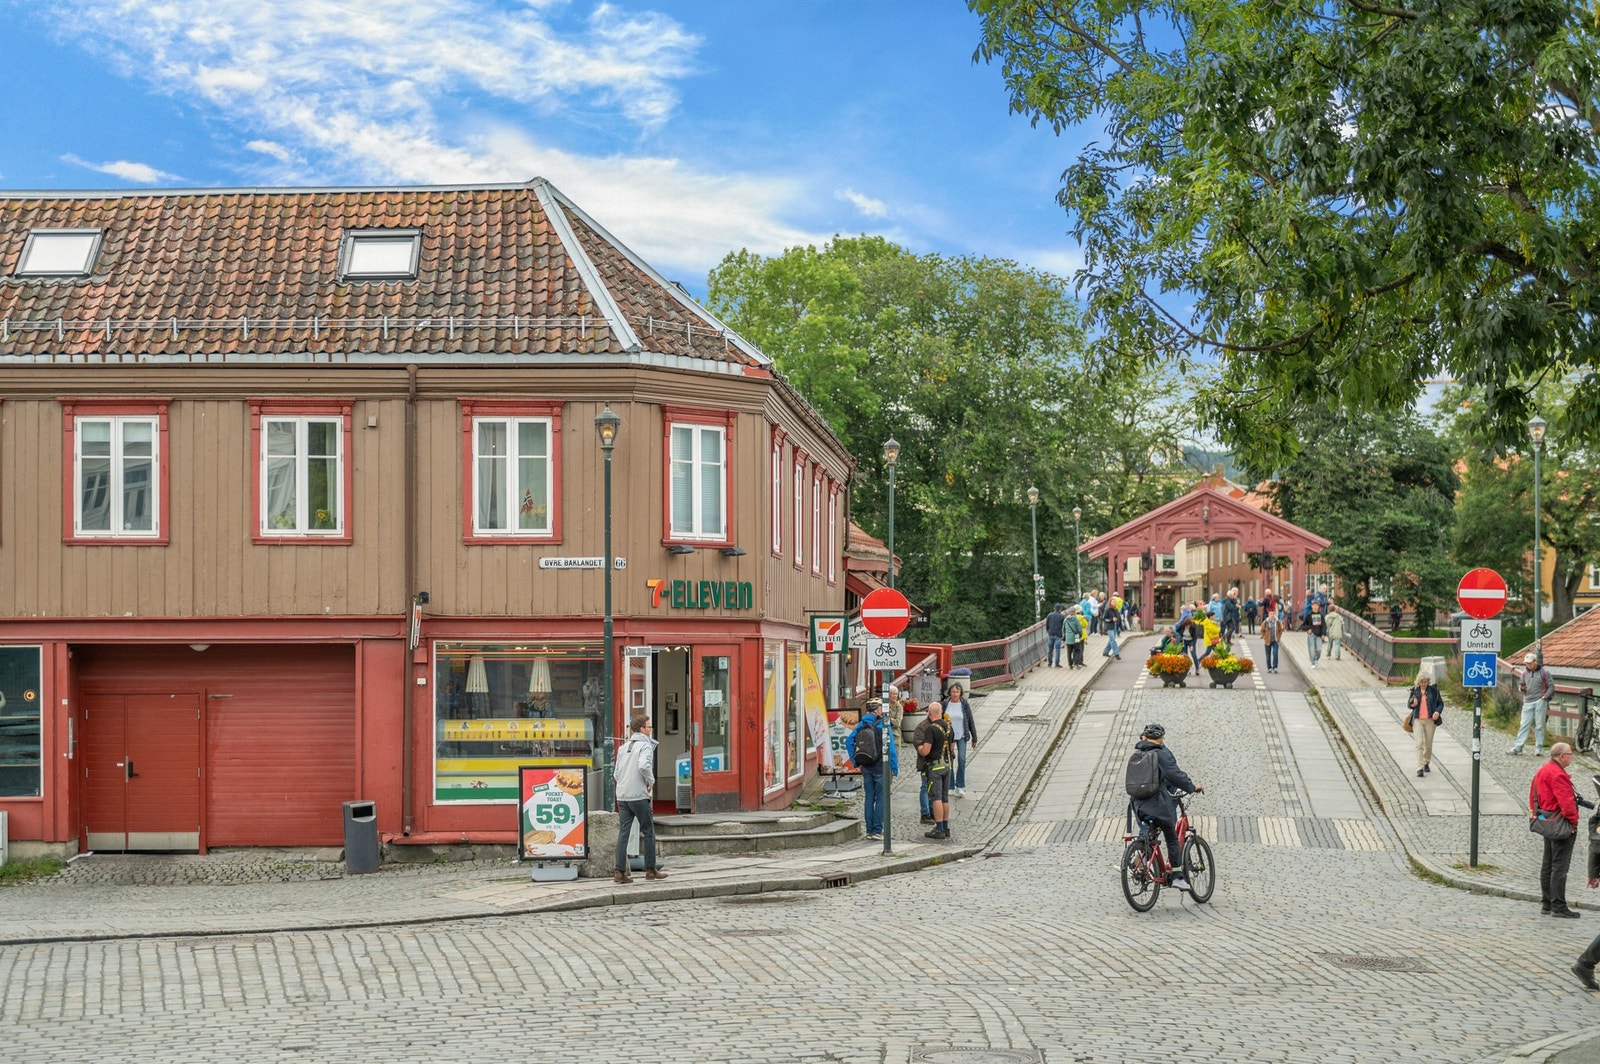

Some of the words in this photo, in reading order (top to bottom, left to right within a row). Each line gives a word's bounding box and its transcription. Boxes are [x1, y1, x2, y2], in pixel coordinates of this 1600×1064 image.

[615, 559, 626, 567] 66
[1466, 641, 1495, 649] Unntatt
[872, 659, 900, 667] Unntatt
